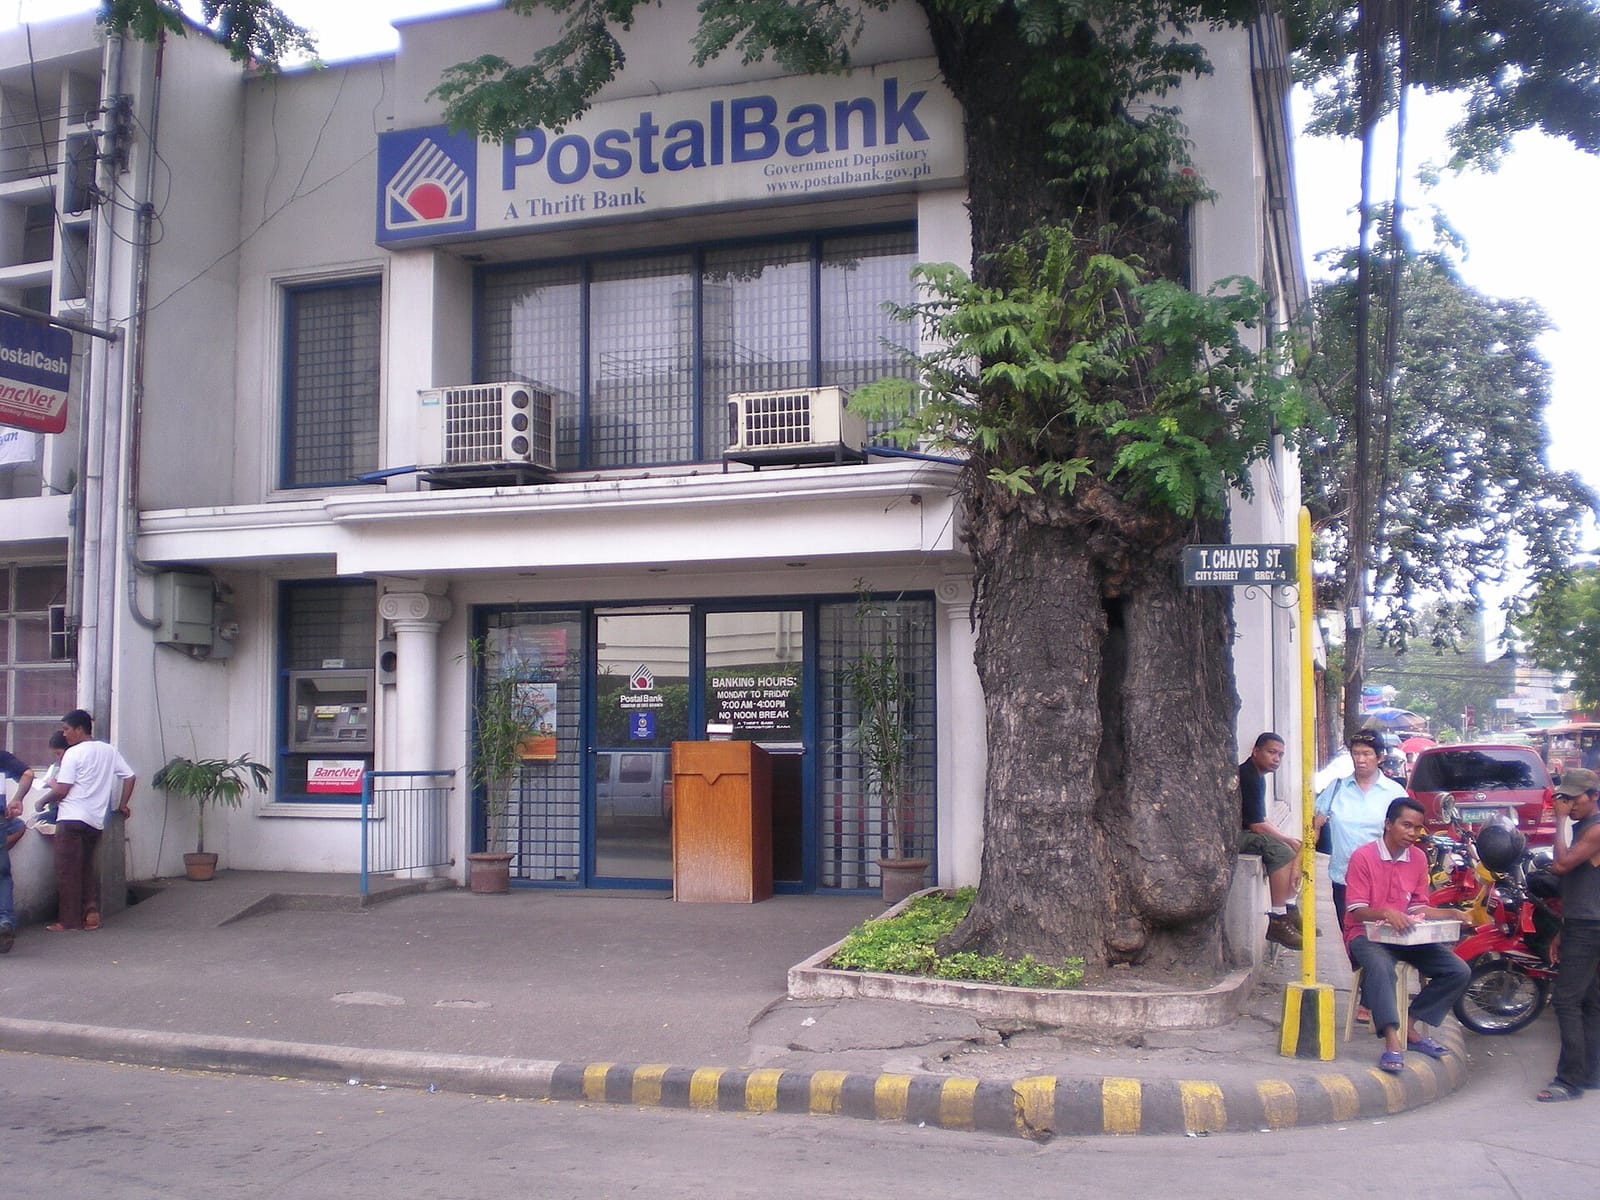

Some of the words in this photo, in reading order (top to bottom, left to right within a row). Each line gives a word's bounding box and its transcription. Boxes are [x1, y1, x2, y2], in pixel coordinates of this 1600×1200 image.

[502, 77, 930, 191] PostalBank
[763, 157, 849, 177] Government
[853, 148, 929, 167] Depository
[766, 162, 931, 192] www.postalbank.gov.ph
[504, 202, 519, 220] A
[526, 192, 585, 217] Thrift
[592, 186, 646, 210] Bank
[0, 347, 68, 375] ostalCash
[0, 384, 56, 408] ancNet
[1200, 550, 1211, 569] T.
[1212, 548, 1259, 569] CHAVES
[1265, 548, 1282, 568] ST.
[1195, 571, 1213, 581] CITY
[1213, 570, 1239, 581] STREET
[712, 677, 755, 688] BANKING
[757, 676, 797, 688] HOURS:
[717, 690, 748, 699] MONDAY
[751, 690, 761, 698] TO
[763, 689, 790, 698] FRIDAY
[718, 711, 731, 719] NO
[733, 711, 757, 719] NOON
[758, 710, 789, 719] BREAK
[314, 767, 361, 777] BancNet
